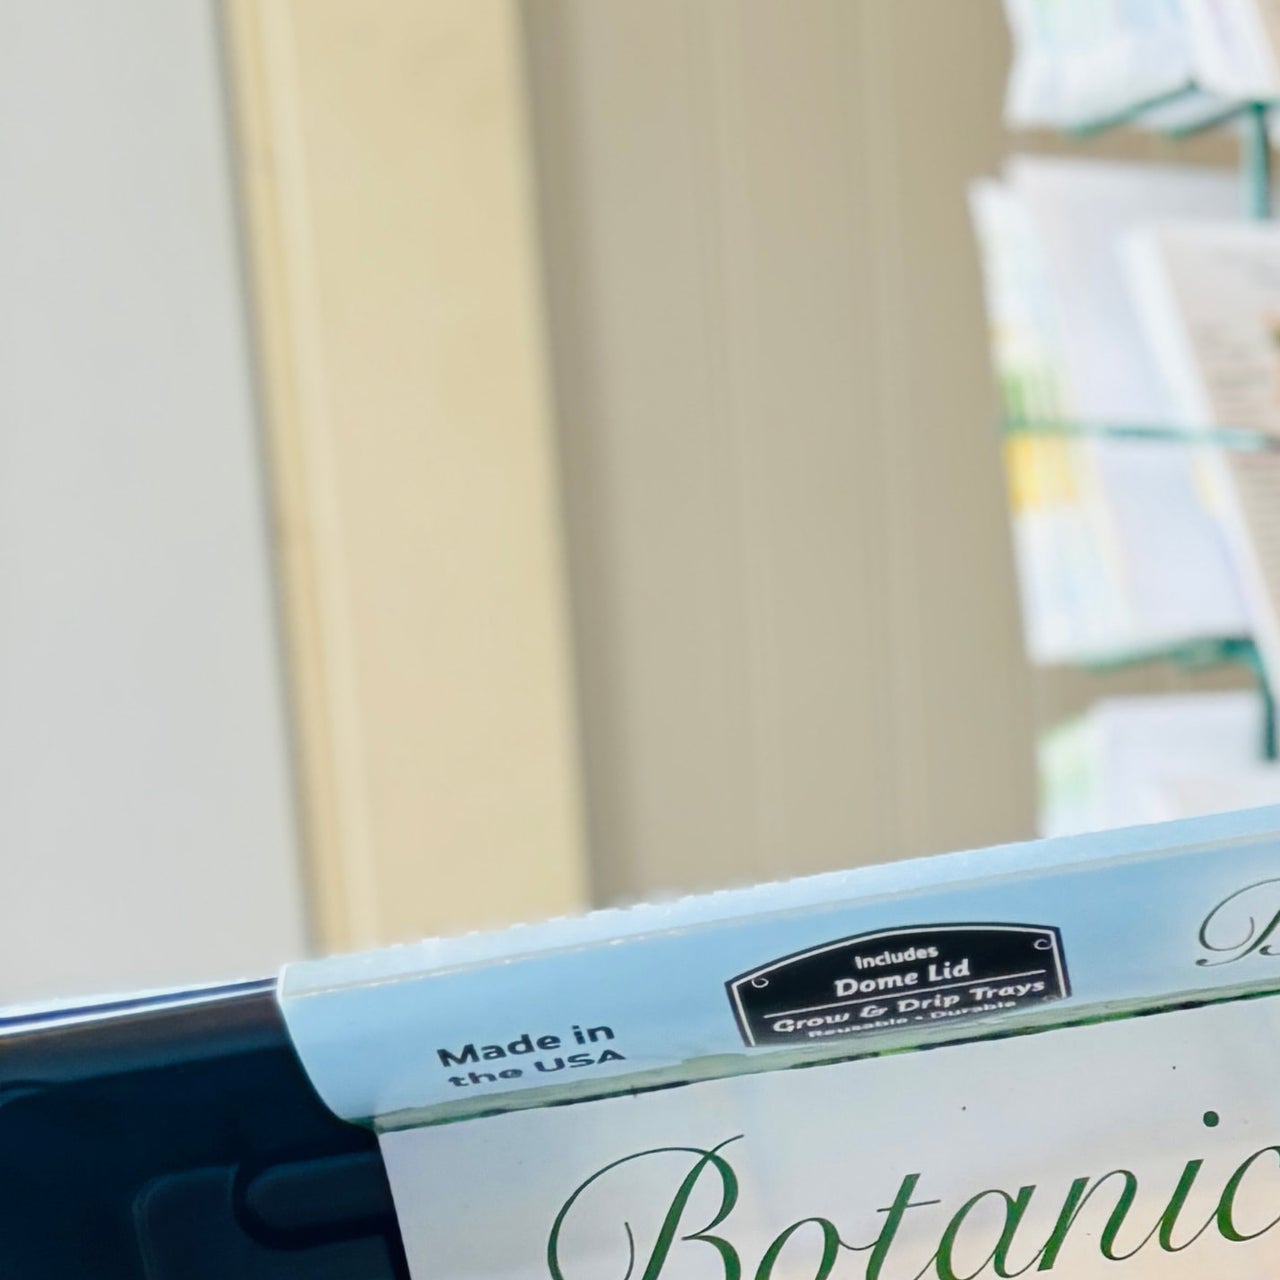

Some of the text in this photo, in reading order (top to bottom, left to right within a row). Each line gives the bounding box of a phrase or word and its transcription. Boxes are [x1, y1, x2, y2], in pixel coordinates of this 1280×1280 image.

[854, 944, 939, 970] Includes
[834, 958, 971, 999] Dome Lid
[771, 978, 1047, 1035] Grow & Drip Trays
[807, 998, 1018, 1038] Reusable Durable
[437, 1021, 616, 1068] Made in
[447, 1049, 627, 1088] the USA
